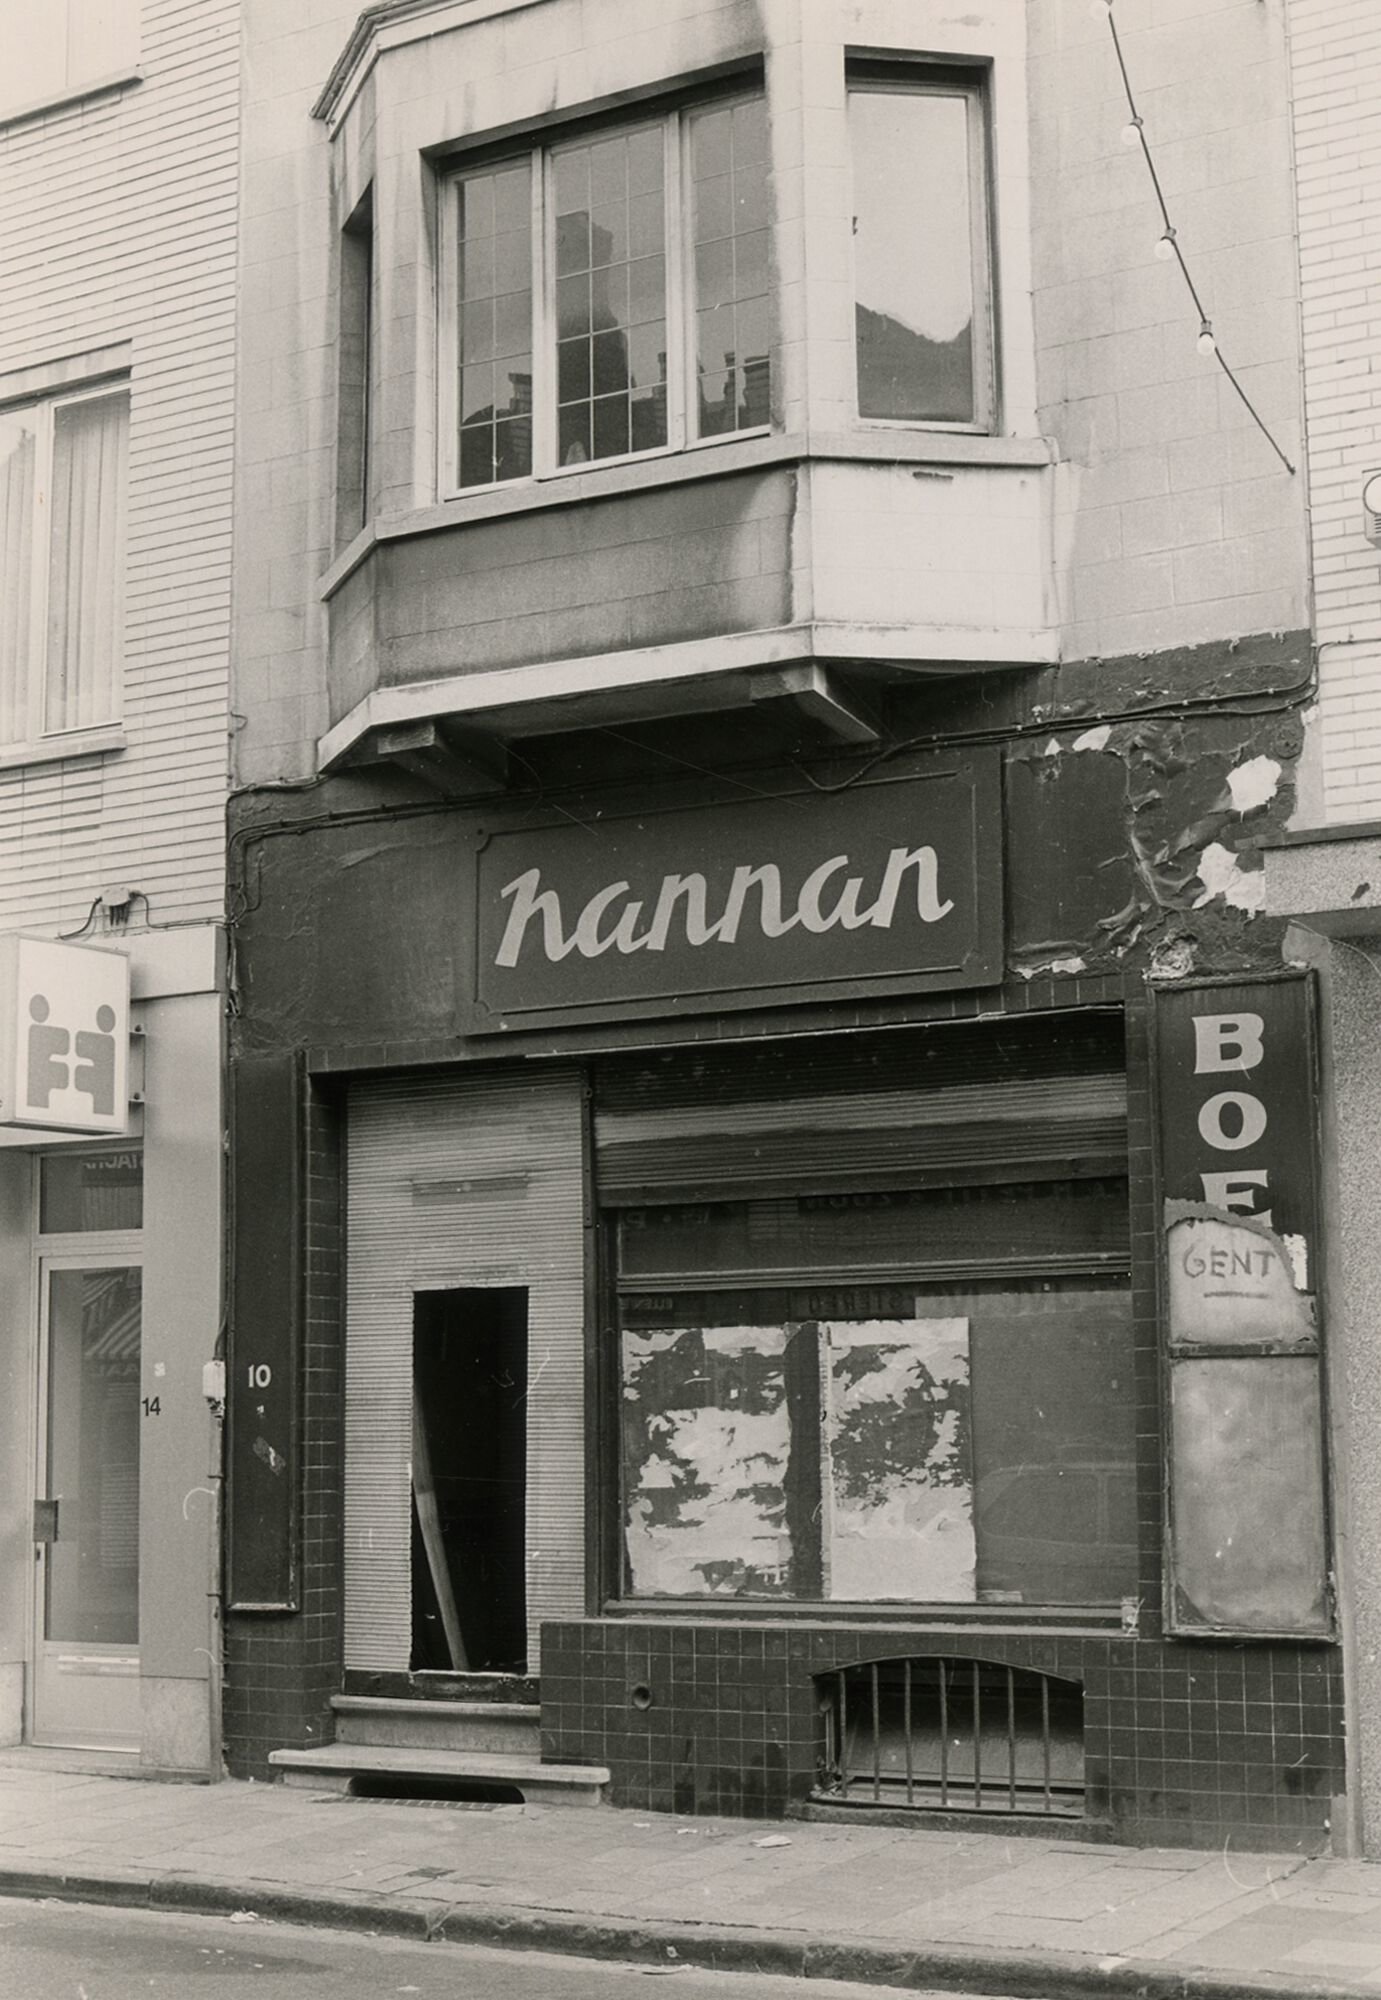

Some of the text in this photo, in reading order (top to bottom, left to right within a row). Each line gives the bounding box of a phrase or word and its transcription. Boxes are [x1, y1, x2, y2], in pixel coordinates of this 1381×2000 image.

[495, 846, 954, 967] hannan
[1182, 1244, 1276, 1278] GENT
[248, 1364, 271, 1388] 10
[141, 1396, 161, 1416] 14
